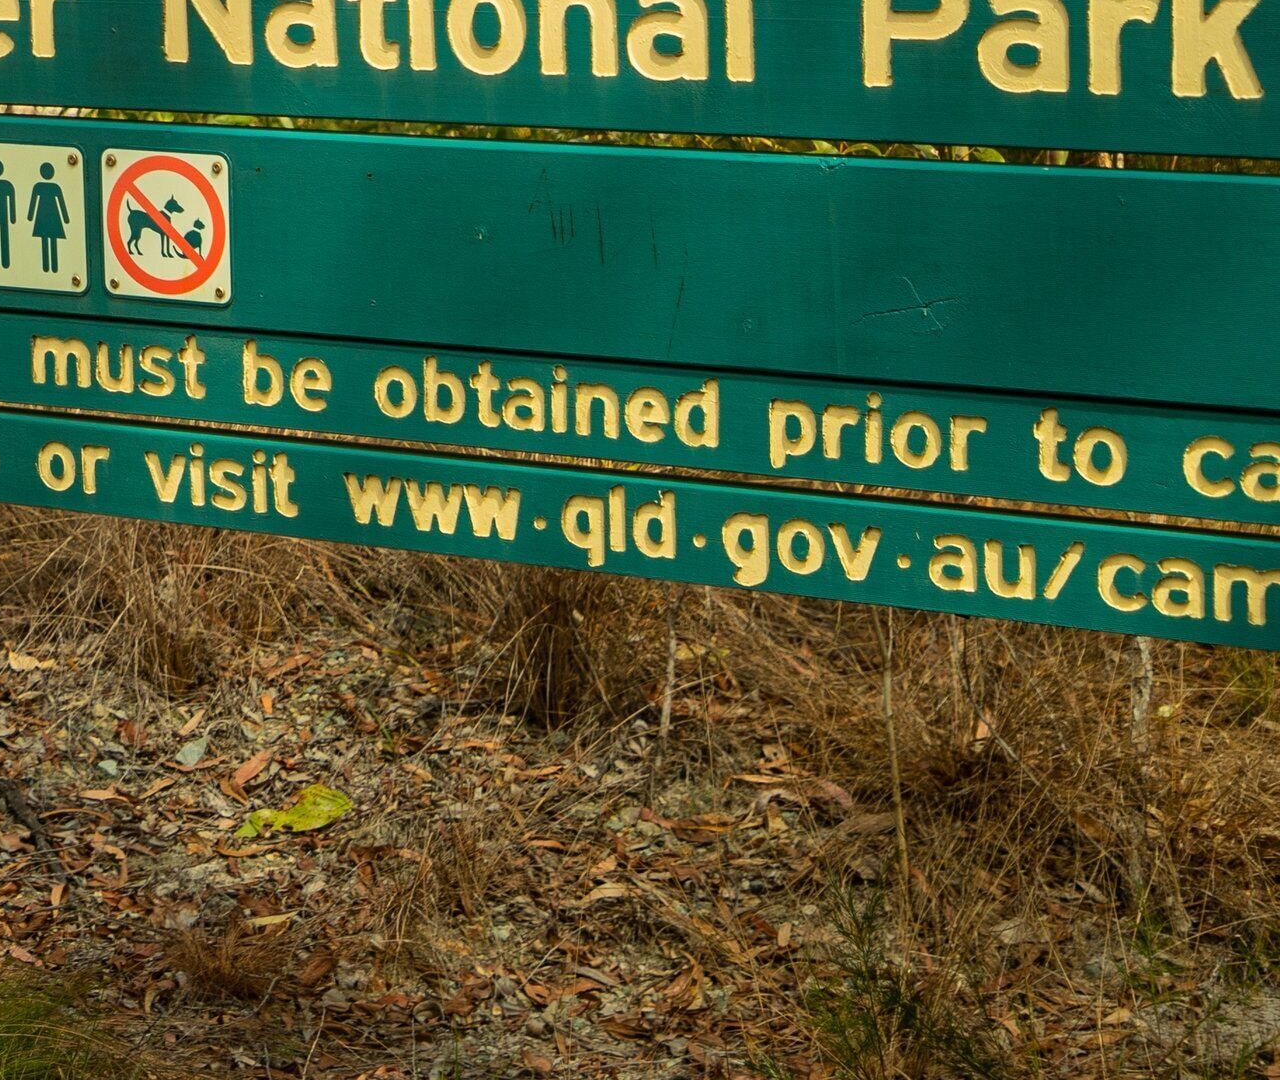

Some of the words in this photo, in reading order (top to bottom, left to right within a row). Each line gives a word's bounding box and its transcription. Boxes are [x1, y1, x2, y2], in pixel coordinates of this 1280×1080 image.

[32, 335, 206, 400] must
[242, 339, 333, 412] be
[374, 356, 720, 449] obtained
[769, 392, 987, 470] prior
[1033, 407, 1128, 486] to
[38, 441, 110, 495] or
[145, 442, 298, 518] visit
